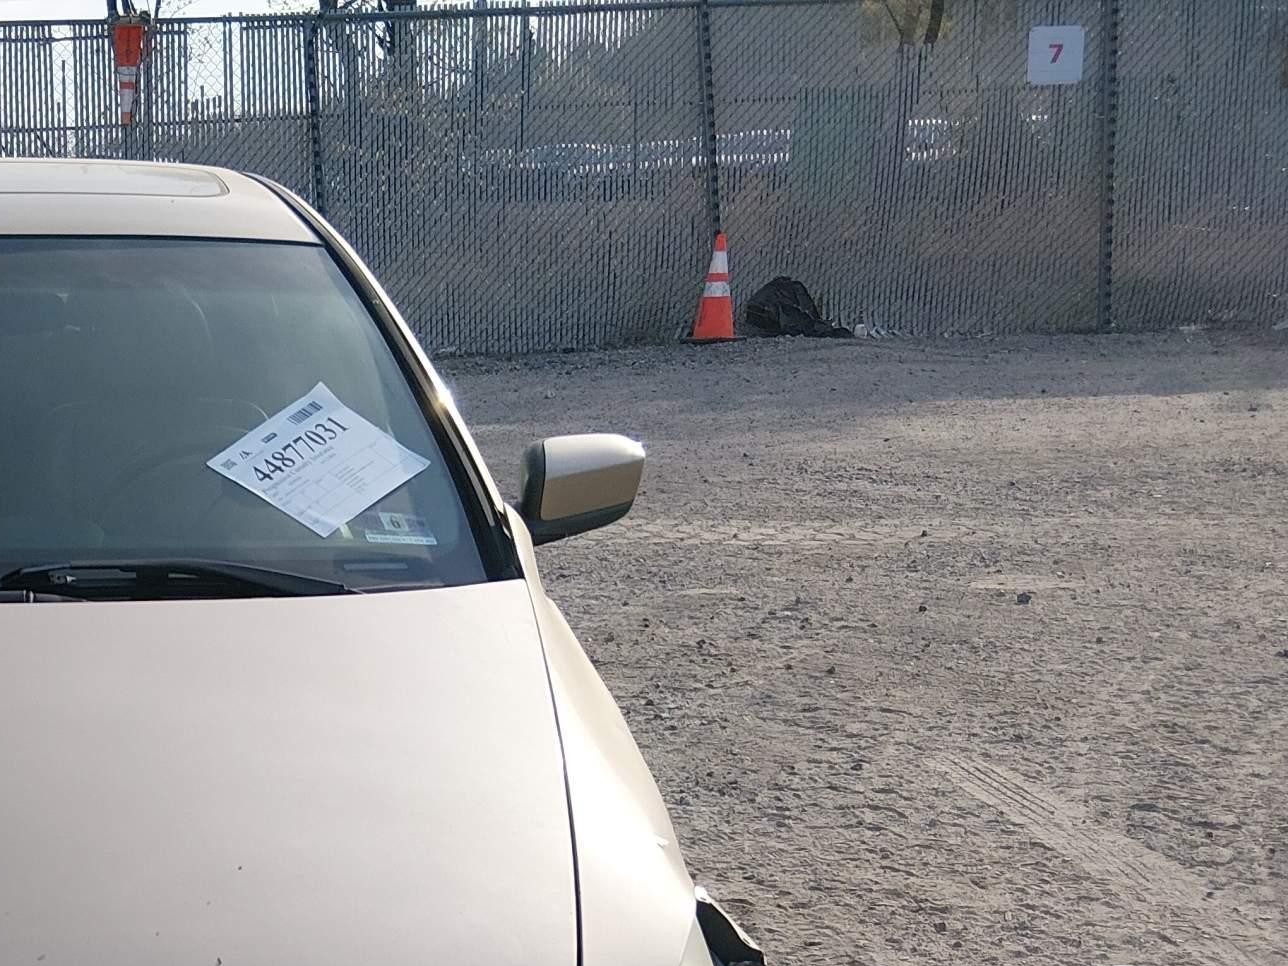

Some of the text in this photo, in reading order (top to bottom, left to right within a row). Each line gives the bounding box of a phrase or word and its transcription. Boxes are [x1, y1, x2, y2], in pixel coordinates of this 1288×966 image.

[1048, 43, 1064, 65] 7
[253, 416, 350, 482] 44877031
[389, 515, 402, 530] 6
